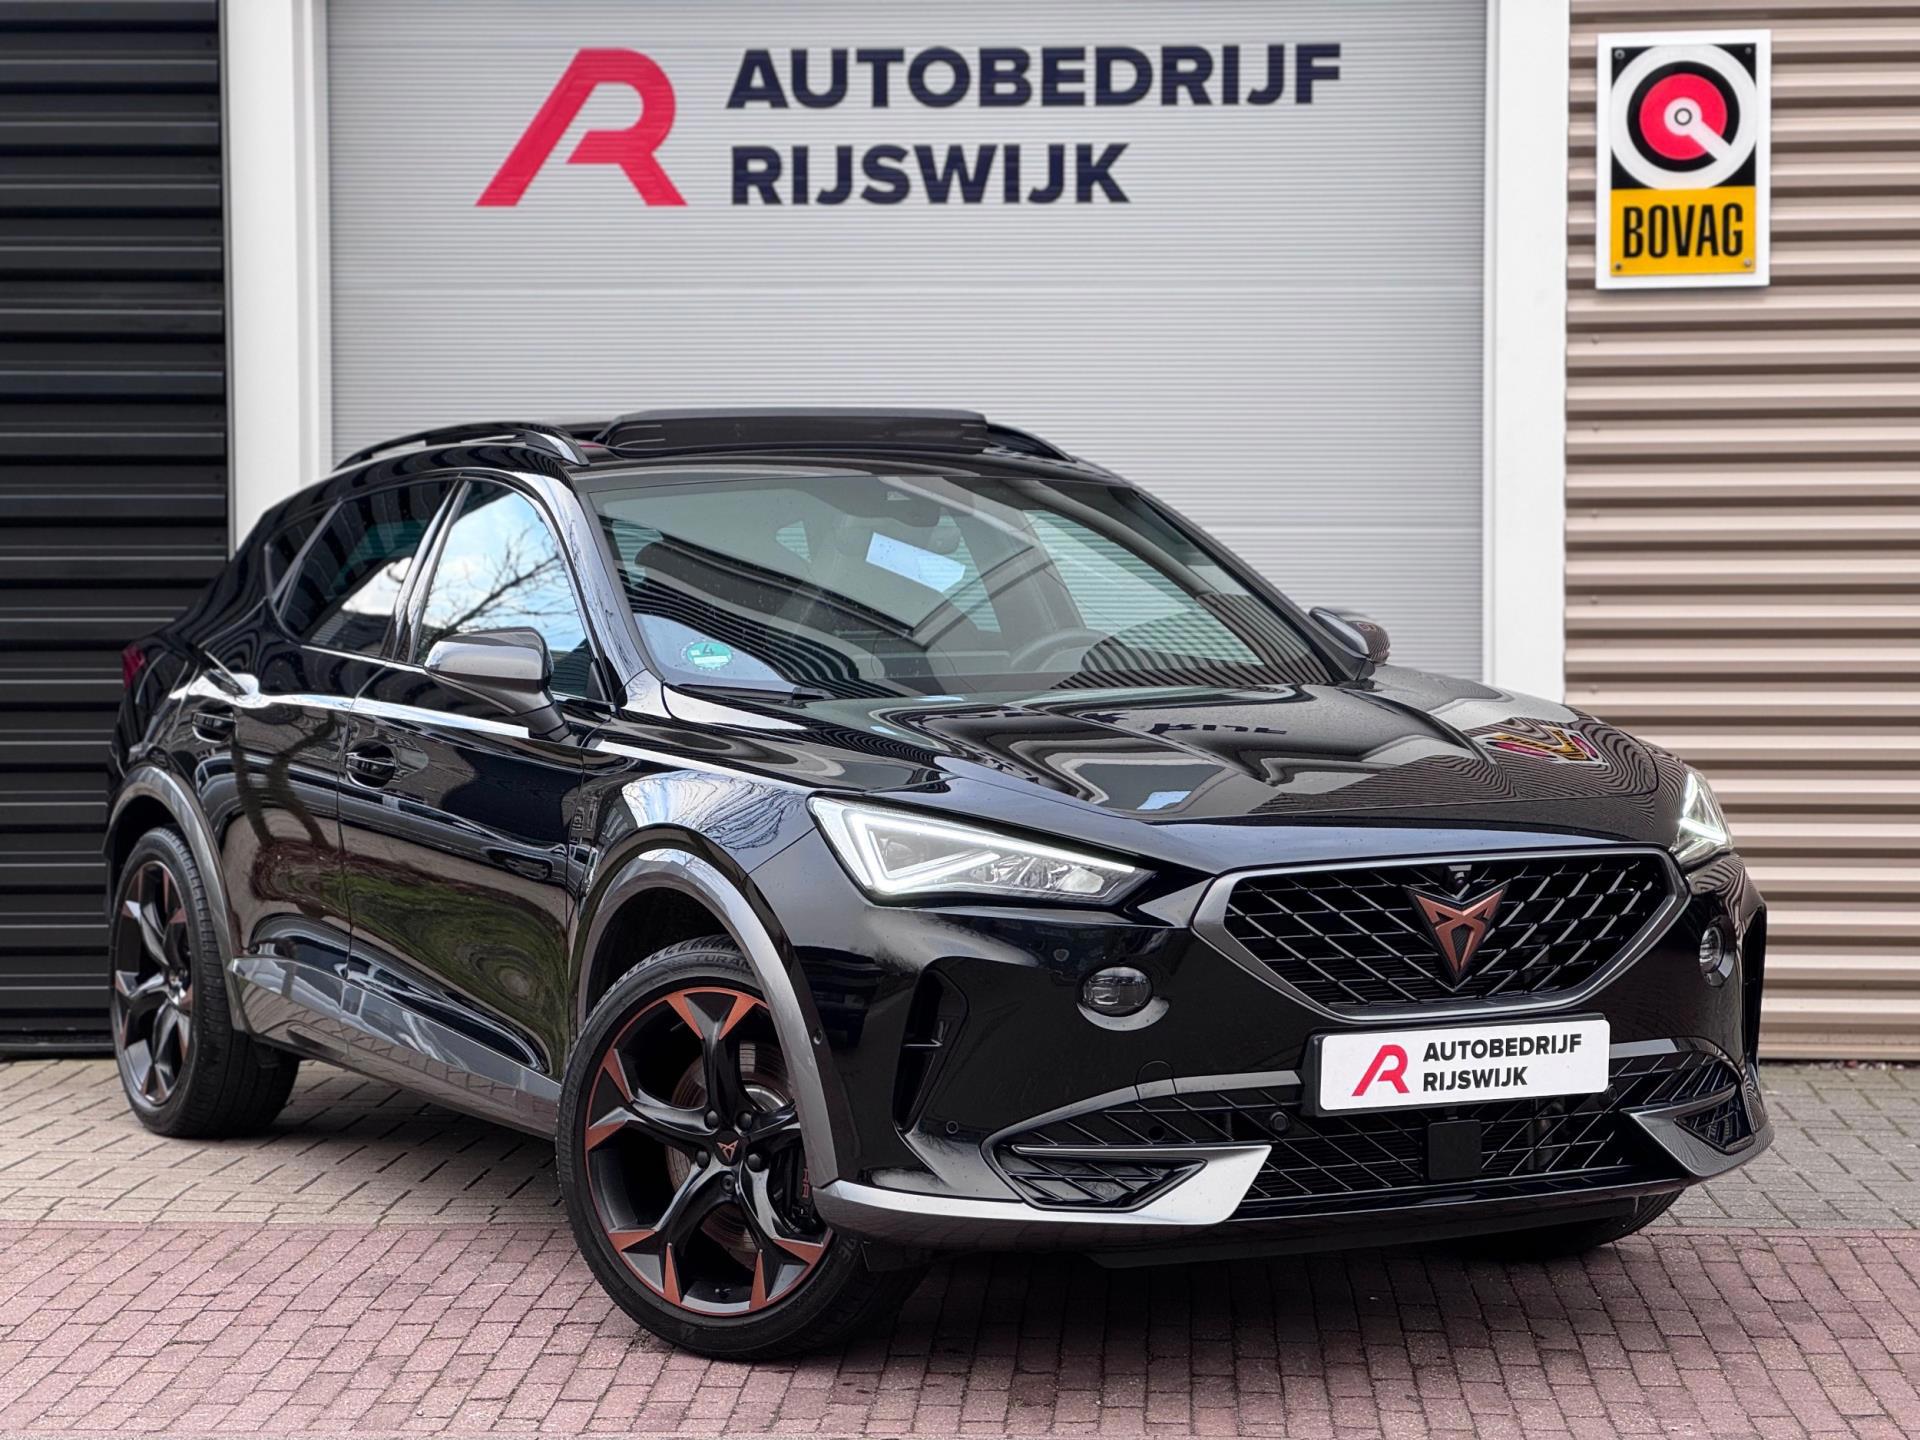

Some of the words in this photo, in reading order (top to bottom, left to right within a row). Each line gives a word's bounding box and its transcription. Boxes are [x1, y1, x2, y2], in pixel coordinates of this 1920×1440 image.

[727, 44, 1342, 110] AUTOBEDRIJF
[731, 144, 1130, 206] RIJSWIJK
[1623, 202, 1744, 259] BOVAG
[703, 644, 714, 655] 4
[1423, 1034, 1582, 1062] AUTOBEDRIJF
[1423, 1066, 1528, 1092] RIJSWIJK
